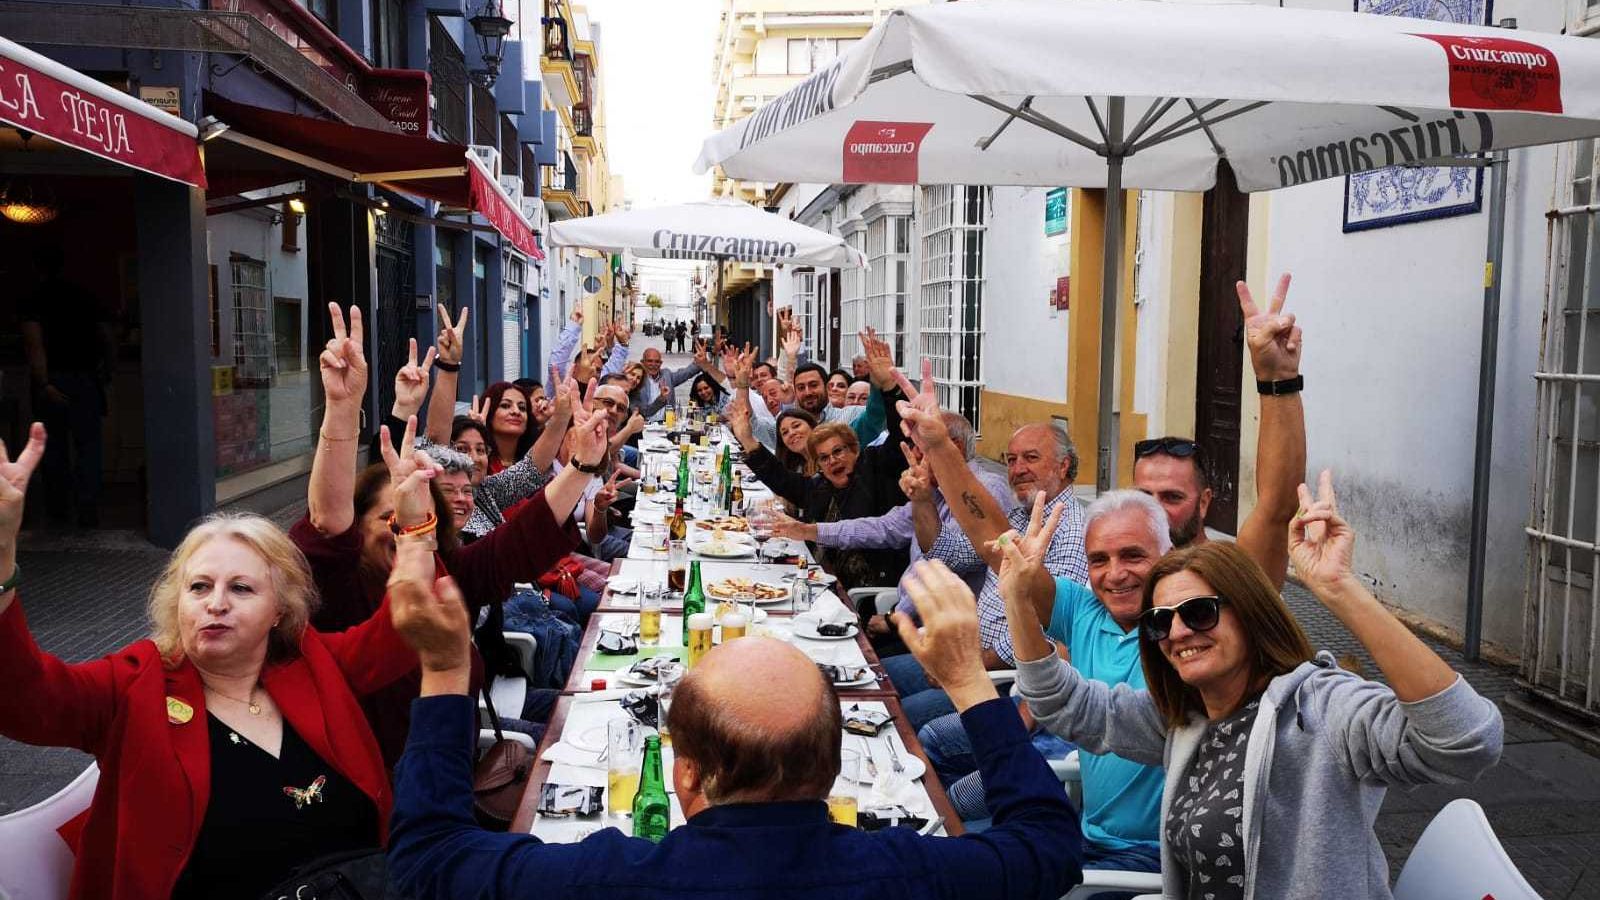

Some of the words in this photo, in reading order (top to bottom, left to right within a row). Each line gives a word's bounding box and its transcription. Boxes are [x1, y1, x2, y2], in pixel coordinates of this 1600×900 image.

[1451, 44, 1547, 69] Cruzcampo
[60, 90, 134, 154] TEJA
[653, 228, 797, 259] Cruzcampo
